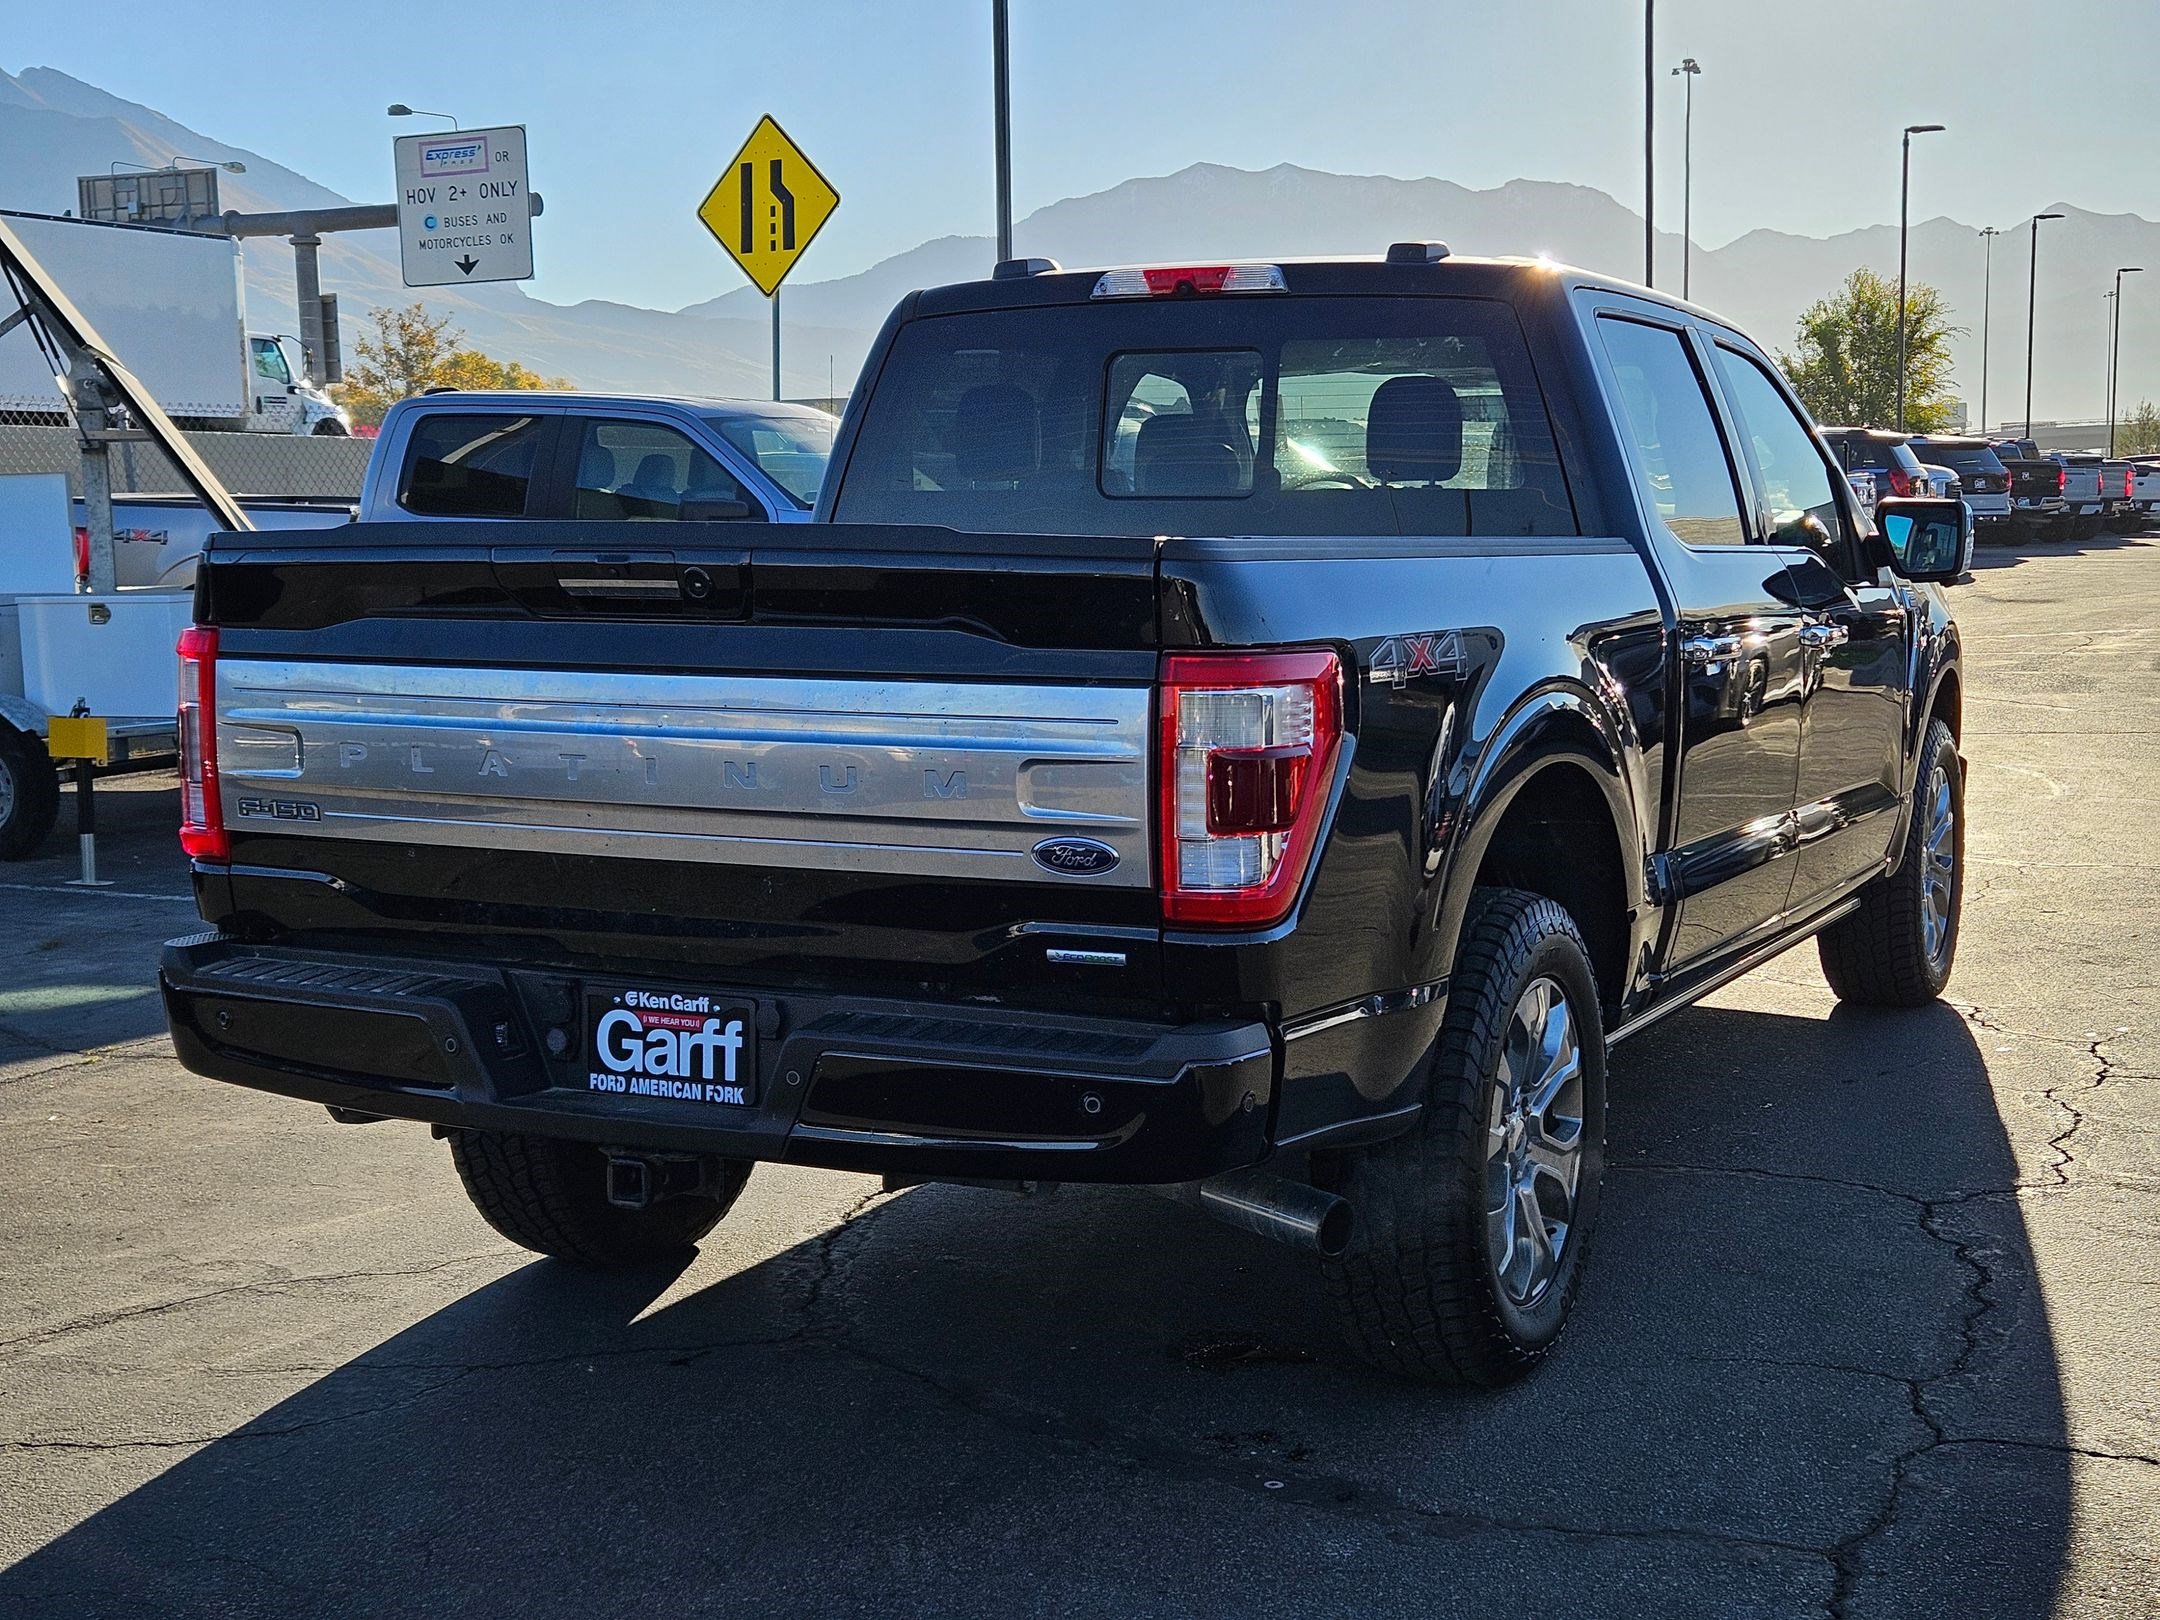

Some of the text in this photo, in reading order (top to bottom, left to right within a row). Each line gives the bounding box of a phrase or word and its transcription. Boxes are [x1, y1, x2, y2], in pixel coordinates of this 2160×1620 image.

[426, 148, 509, 162] Express OR
[406, 180, 518, 204] HOV 2+ ONLY
[444, 214, 478, 228] BUSES
[486, 212, 507, 224] AND
[419, 233, 514, 250] MOTORCYCLES OK
[339, 741, 967, 799] PLATINUM
[238, 797, 321, 821] F-150
[1050, 845, 1098, 868] Ford
[638, 992, 710, 1013] Ken Garff
[648, 1016, 696, 1027] WE HEAR YOU
[597, 1009, 743, 1082] Garff
[589, 1073, 745, 1105] FORD AMERICAN FORK
